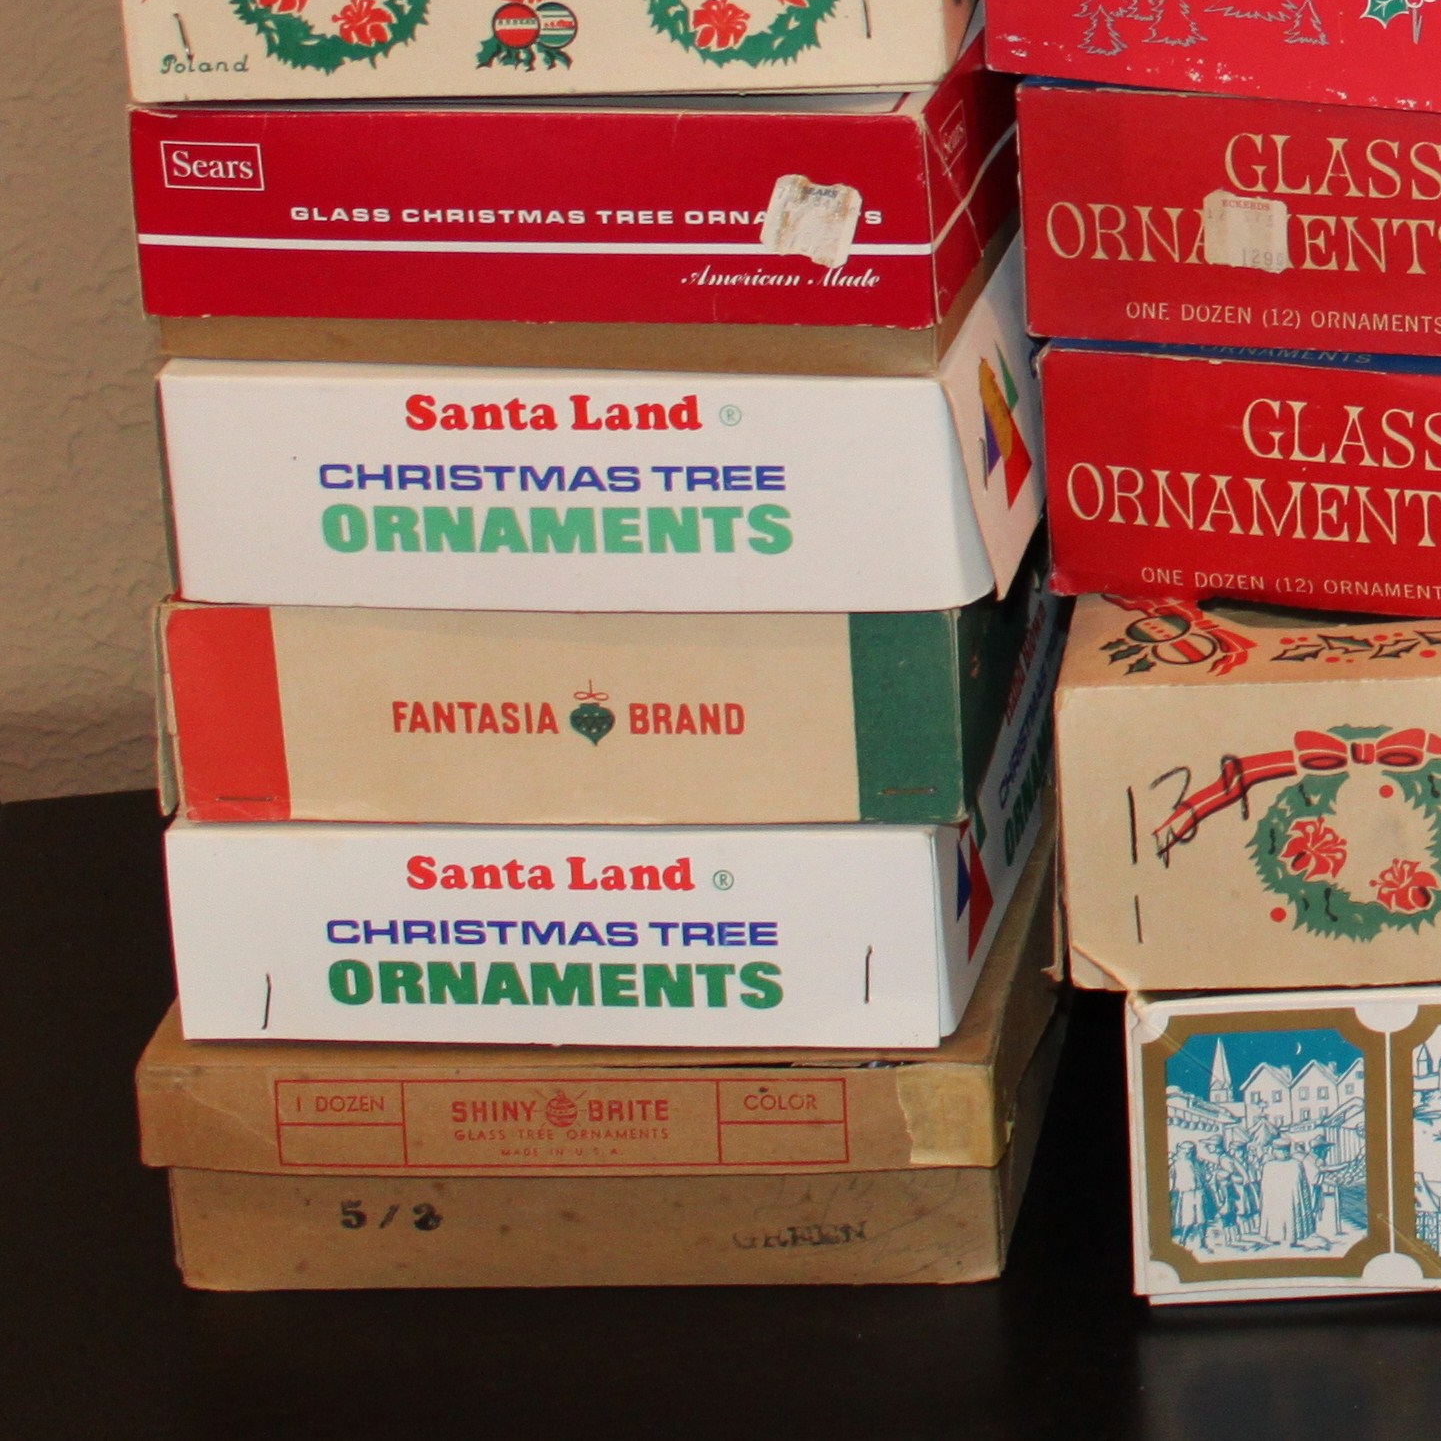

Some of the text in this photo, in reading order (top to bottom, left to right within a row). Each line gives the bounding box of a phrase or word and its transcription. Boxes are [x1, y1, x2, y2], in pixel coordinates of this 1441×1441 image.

[160, 49, 249, 75] Poland
[170, 150, 253, 182] Sears
[290, 207, 391, 226] GLASS
[401, 207, 587, 226] CHRISTMAS
[596, 209, 675, 227] TREE
[682, 266, 881, 289] American Made
[1126, 301, 1170, 321] ONE
[1180, 303, 1254, 324] DOZEN
[1261, 306, 1301, 329] (12)
[405, 394, 559, 432] Santa
[571, 395, 703, 432] Land
[318, 464, 787, 494] CHRISTMAS TREE
[320, 503, 793, 556] ORNAMENTS
[1141, 568, 1185, 588] ONE
[1194, 570, 1268, 592] DOZEN
[1274, 573, 1316, 596] (12)
[392, 699, 746, 736] FANTASIA BRAND
[406, 855, 556, 892] Santa
[566, 857, 696, 892] Land
[326, 918, 780, 948] CHRISTMAS TREE
[327, 960, 784, 1010] ORNAMENTS
[315, 1095, 385, 1113] DOZEN
[451, 1099, 670, 1123] SHINY BRITE
[743, 1093, 817, 1112] COLOR
[454, 1128, 670, 1142] GLASS TREE ORNAMENTS
